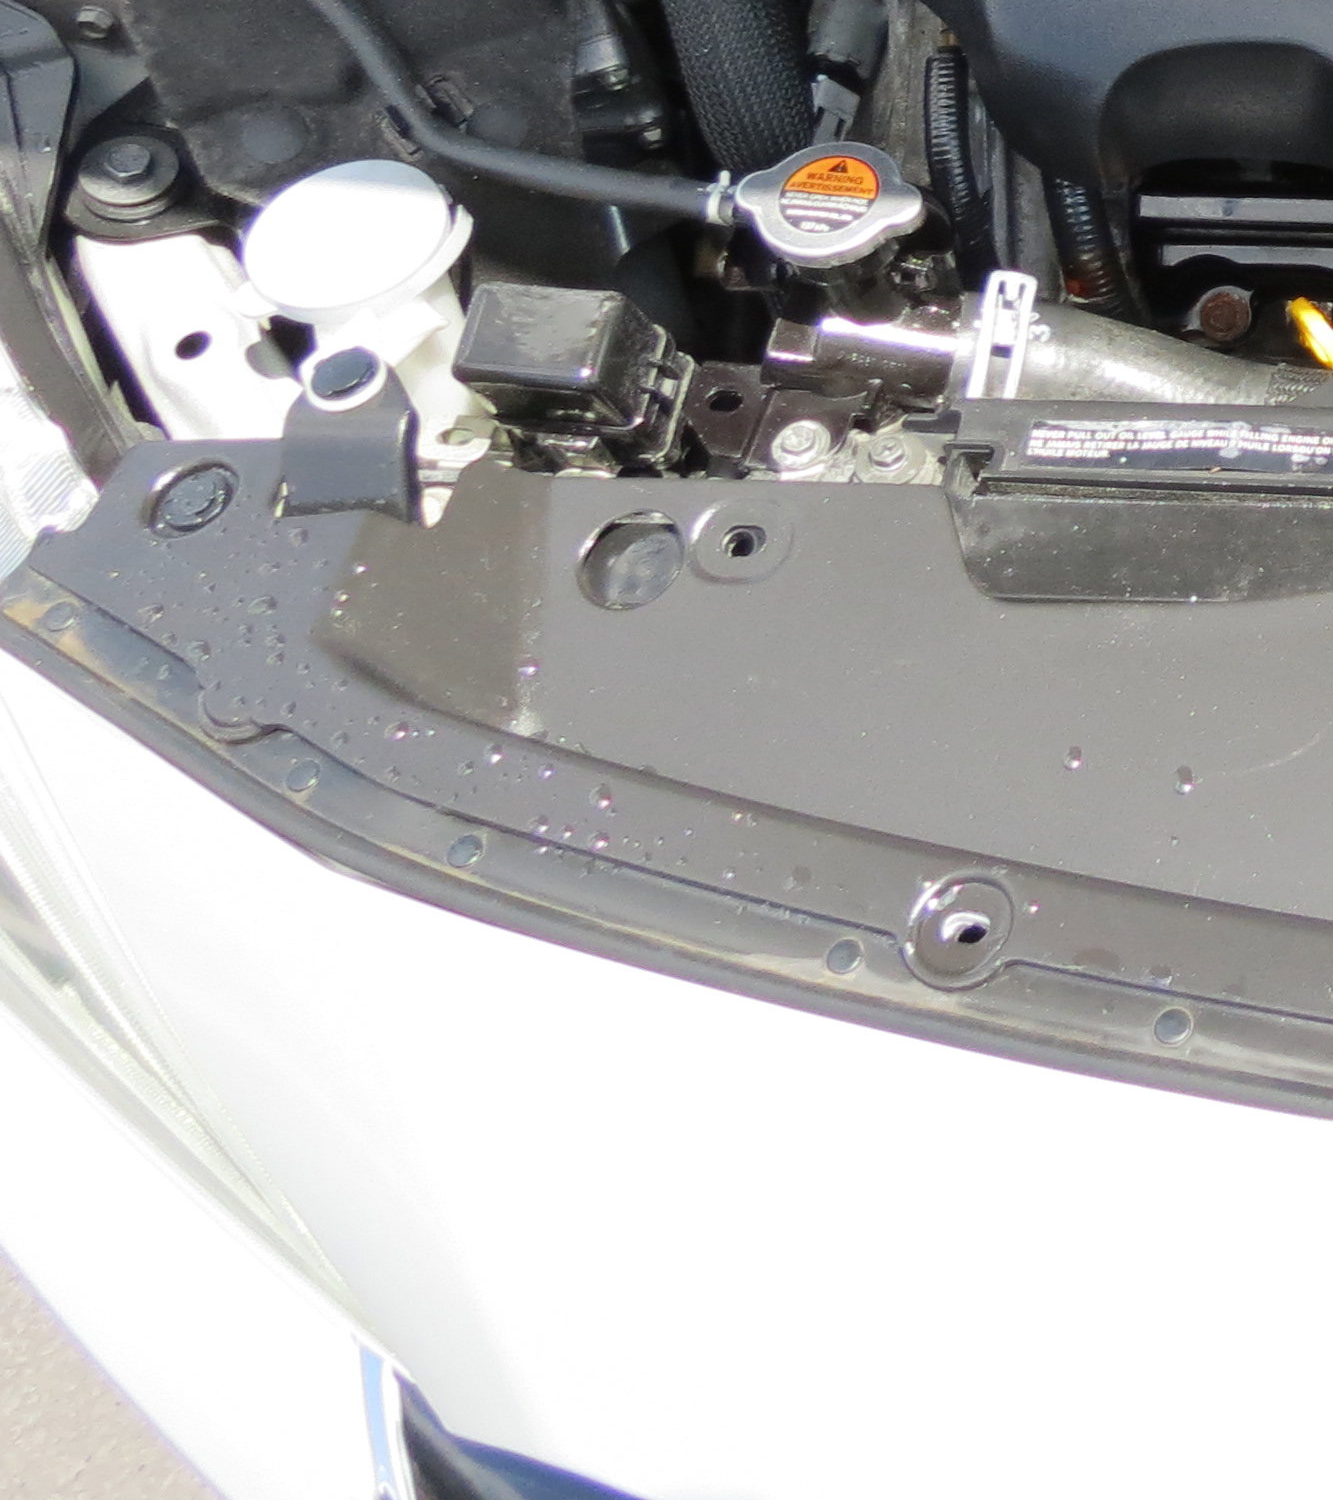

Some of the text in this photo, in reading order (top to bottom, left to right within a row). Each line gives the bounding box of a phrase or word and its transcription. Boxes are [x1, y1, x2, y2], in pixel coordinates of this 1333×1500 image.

[806, 172, 864, 185] WARNING
[789, 181, 875, 195] AVERTISSEMENT
[1031, 429, 1066, 440] NEVER
[1067, 430, 1092, 440] PULL
[1094, 431, 1117, 441] OUT
[1117, 430, 1135, 441] OIL
[1136, 430, 1167, 441] LEVEL
[1169, 429, 1205, 440] GAUGE
[1207, 428, 1237, 439] WHILE
[1239, 430, 1279, 442] FILLING
[1282, 434, 1320, 444] ENGINE
[1029, 439, 1044, 448] NE
[1046, 440, 1081, 449] JAMAIS
[1083, 440, 1125, 450] RETIRER
[1126, 440, 1140, 450] LA
[1141, 440, 1174, 450] JAUGE
[1175, 440, 1189, 449] DE
[1191, 438, 1228, 449] NIVEAU
